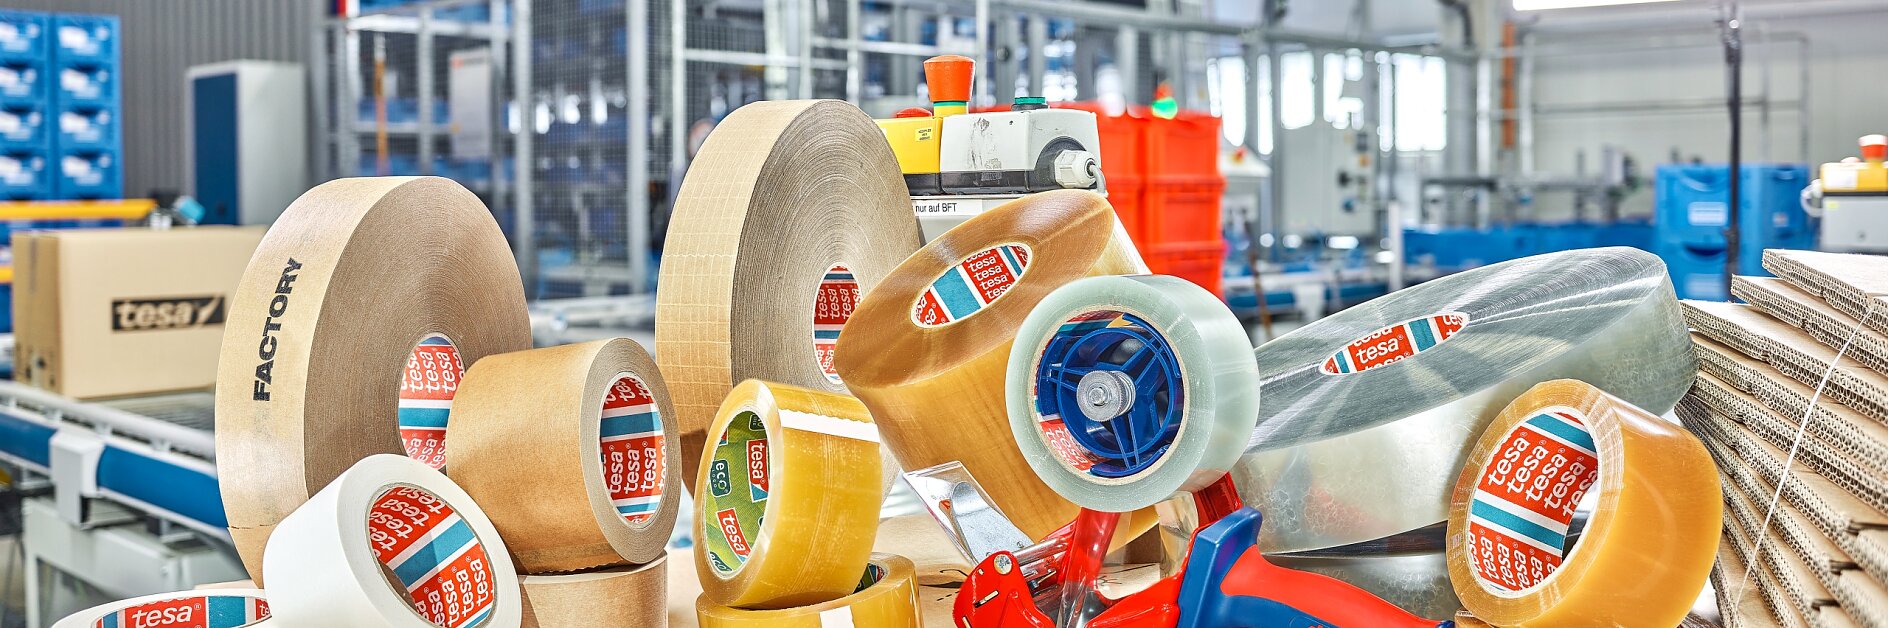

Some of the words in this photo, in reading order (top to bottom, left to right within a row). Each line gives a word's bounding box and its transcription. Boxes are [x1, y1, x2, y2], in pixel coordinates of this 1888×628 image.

[929, 203, 940, 212] auf
[942, 203, 957, 212] BFT
[968, 256, 996, 273] tesa
[974, 265, 1003, 281] tesa
[980, 274, 1008, 290] tesa
[115, 301, 193, 330] tesa
[828, 288, 840, 320] tesa
[253, 257, 303, 401] FACTORY
[419, 351, 441, 394] tesa
[434, 351, 457, 394] tesa
[1356, 338, 1399, 364] tesa
[610, 451, 623, 494] tesa
[624, 449, 640, 495] tesa
[641, 447, 657, 493] tesa
[715, 462, 728, 490] eco
[750, 442, 765, 481] tesa
[1488, 437, 1530, 487] tesa
[1507, 445, 1549, 494] tesa
[1525, 453, 1568, 502] tesa
[1543, 461, 1587, 510] tesa
[381, 499, 430, 527] tesa
[722, 514, 747, 552] tesa
[1480, 536, 1500, 580] tesa
[1497, 543, 1517, 587] tesa
[442, 580, 460, 628] tesa
[456, 569, 475, 618] tesa
[470, 559, 490, 607] tesa
[131, 605, 193, 628] tesa
